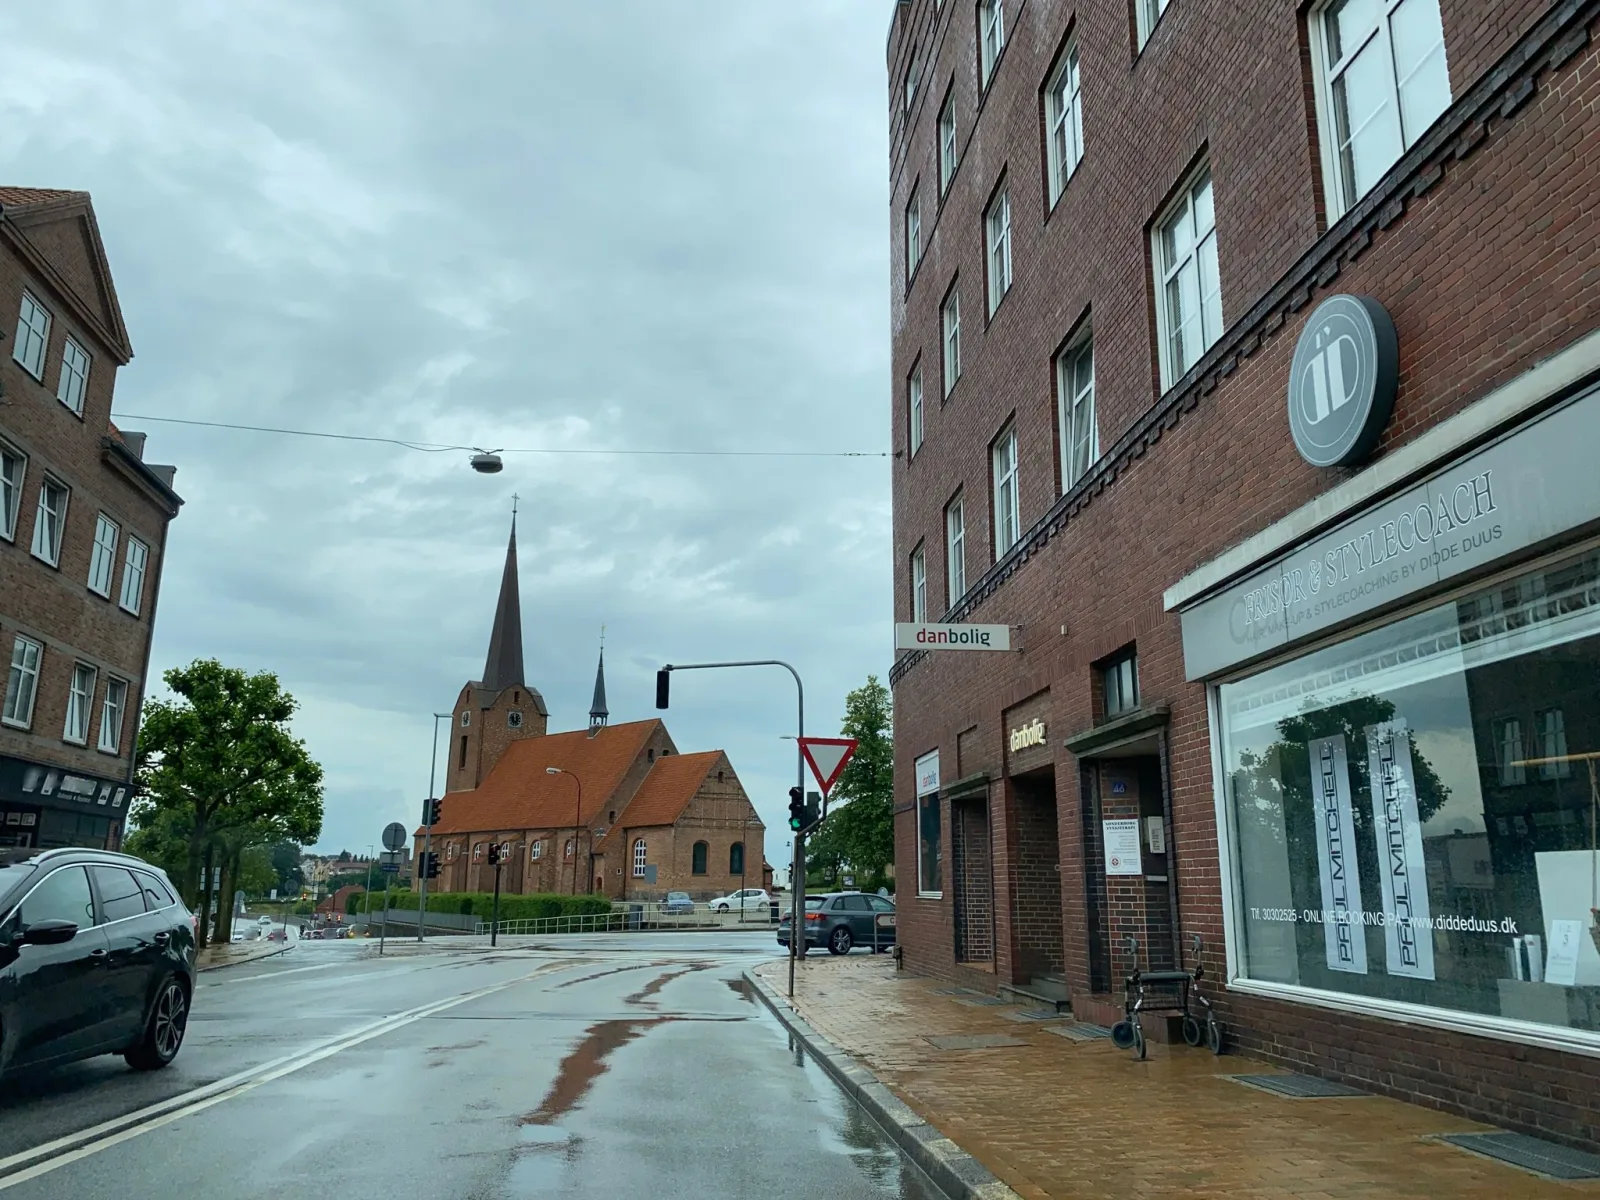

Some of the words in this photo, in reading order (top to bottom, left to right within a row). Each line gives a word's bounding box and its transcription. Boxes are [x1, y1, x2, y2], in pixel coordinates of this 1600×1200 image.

[1309, 560, 1321, 594] &
[1324, 469, 1497, 587] STYLECOACH
[1314, 570, 1399, 616] STYLECOACHING
[1401, 561, 1416, 578] BY
[1420, 543, 1459, 572] DIDDE
[1462, 525, 1502, 553] DUUS
[916, 628, 991, 647] danbolig
[1010, 717, 1047, 752] danbolig
[1113, 784, 1125, 793] 46
[1321, 743, 1344, 880] MITCHELL
[1262, 908, 1297, 922] 30302525
[1303, 909, 1336, 925] ONLINE
[1337, 911, 1385, 926] BOOKING
[1409, 914, 1518, 934] www.diddeduus.dk
[1334, 885, 1351, 962] PAUL
[1396, 881, 1416, 967] PAUL
